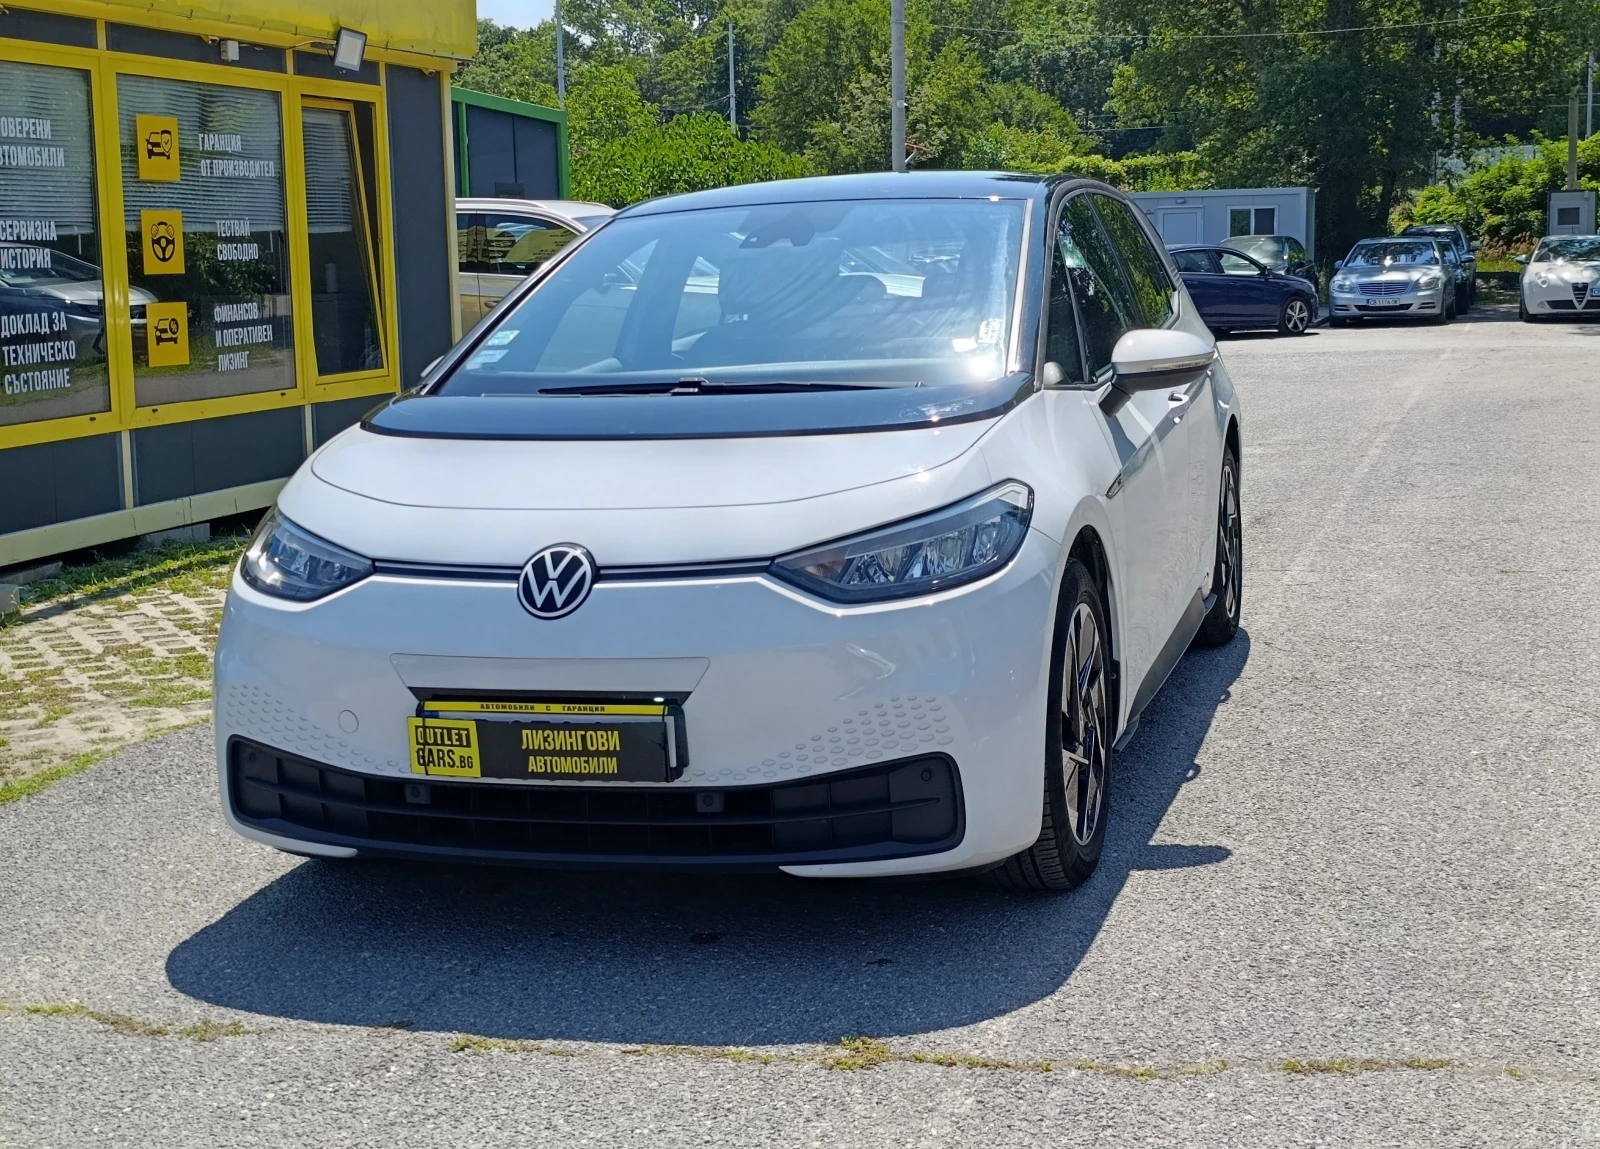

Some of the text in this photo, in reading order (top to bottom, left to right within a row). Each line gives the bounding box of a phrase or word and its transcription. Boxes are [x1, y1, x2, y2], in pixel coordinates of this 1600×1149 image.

[198, 134, 242, 153] ГАРАНЦИЯ
[200, 159, 275, 179] ОТ ПРОИЗВОДИТЕЛ
[0, 220, 58, 241] СЕРВИЗНА
[215, 217, 251, 237] ТЕСТВАЙ
[0, 248, 52, 269] ИСТОРИЯ
[217, 243, 259, 262] СВОБОДНО
[214, 302, 259, 323] ФИНАНСОВ
[0, 311, 68, 339] ДОКЛАД ЗА
[215, 324, 273, 348] И ОПЕРАТИВЕН
[2, 340, 76, 367] ТЕХНИЧЕСКО
[218, 351, 250, 372] ЛИЗИНГ
[4, 367, 71, 395] СЪСТОЯНИЕ
[522, 548, 589, 612] VW
[480, 703, 535, 711] АВТОМОБИЛИ
[562, 705, 606, 713] ГАРАНЦИЯ
[417, 727, 468, 746] OUTLET
[521, 729, 621, 751] ЛИЗИНГОВИ
[416, 747, 474, 769] CARS.BG
[528, 755, 618, 774] АВТОМОБИЛИ
